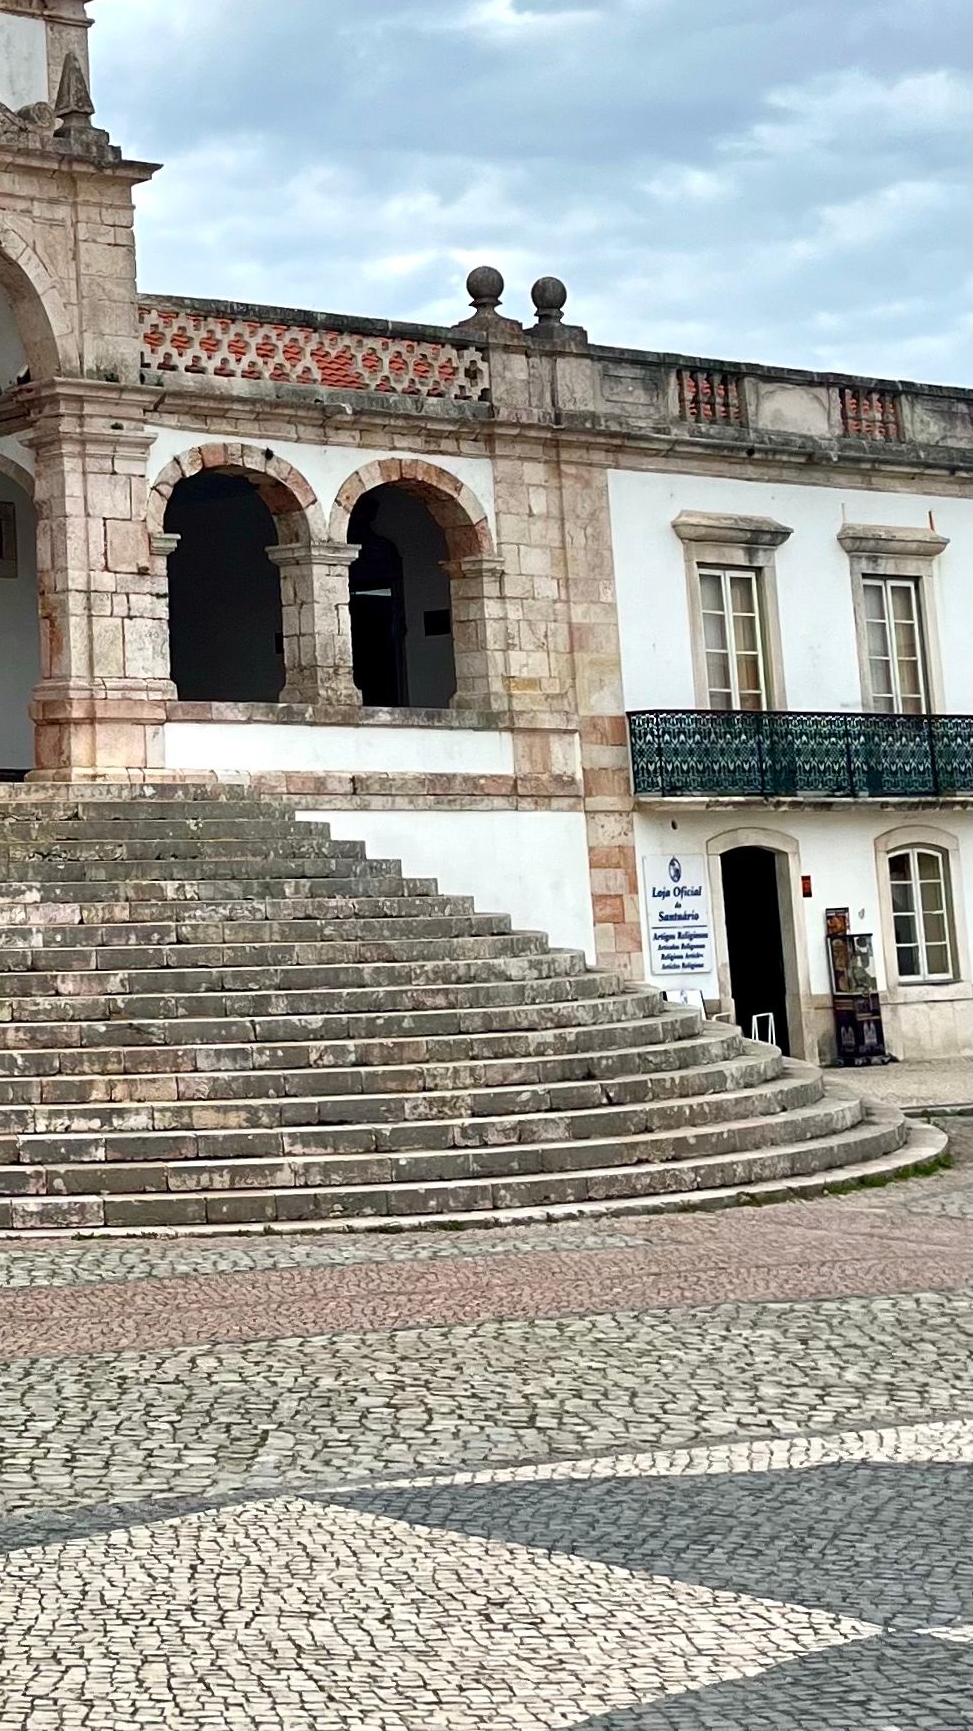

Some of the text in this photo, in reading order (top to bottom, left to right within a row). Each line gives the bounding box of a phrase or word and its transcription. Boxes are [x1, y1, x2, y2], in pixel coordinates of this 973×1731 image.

[652, 886, 702, 900] Loja Oficial
[658, 910, 700, 922] Santuário
